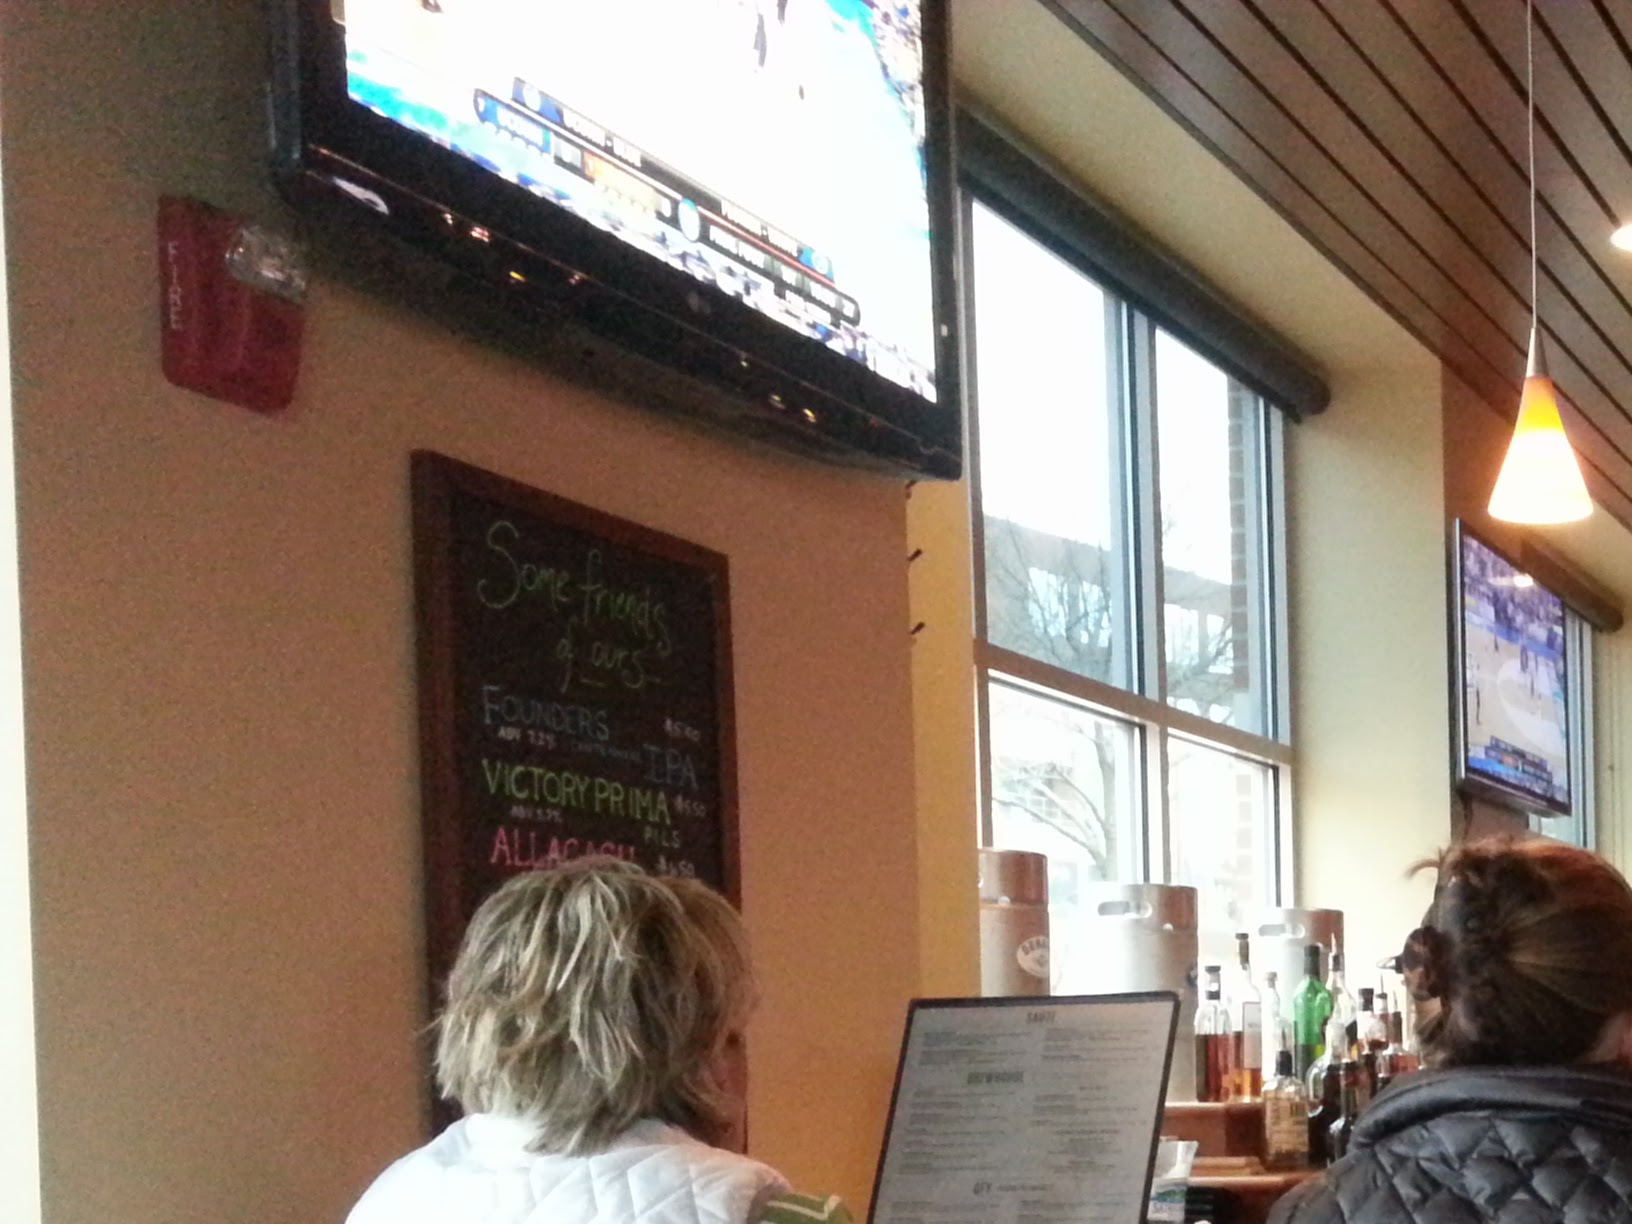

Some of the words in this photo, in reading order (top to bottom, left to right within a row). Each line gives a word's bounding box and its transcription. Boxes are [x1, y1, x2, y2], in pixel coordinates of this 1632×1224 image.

[476, 520, 571, 613] Some
[579, 548, 673, 657] friends
[481, 683, 610, 741] FOUNDERS
[481, 757, 589, 808] VICTORY
[594, 778, 672, 826] PRIMA
[643, 742, 699, 791] IPA
